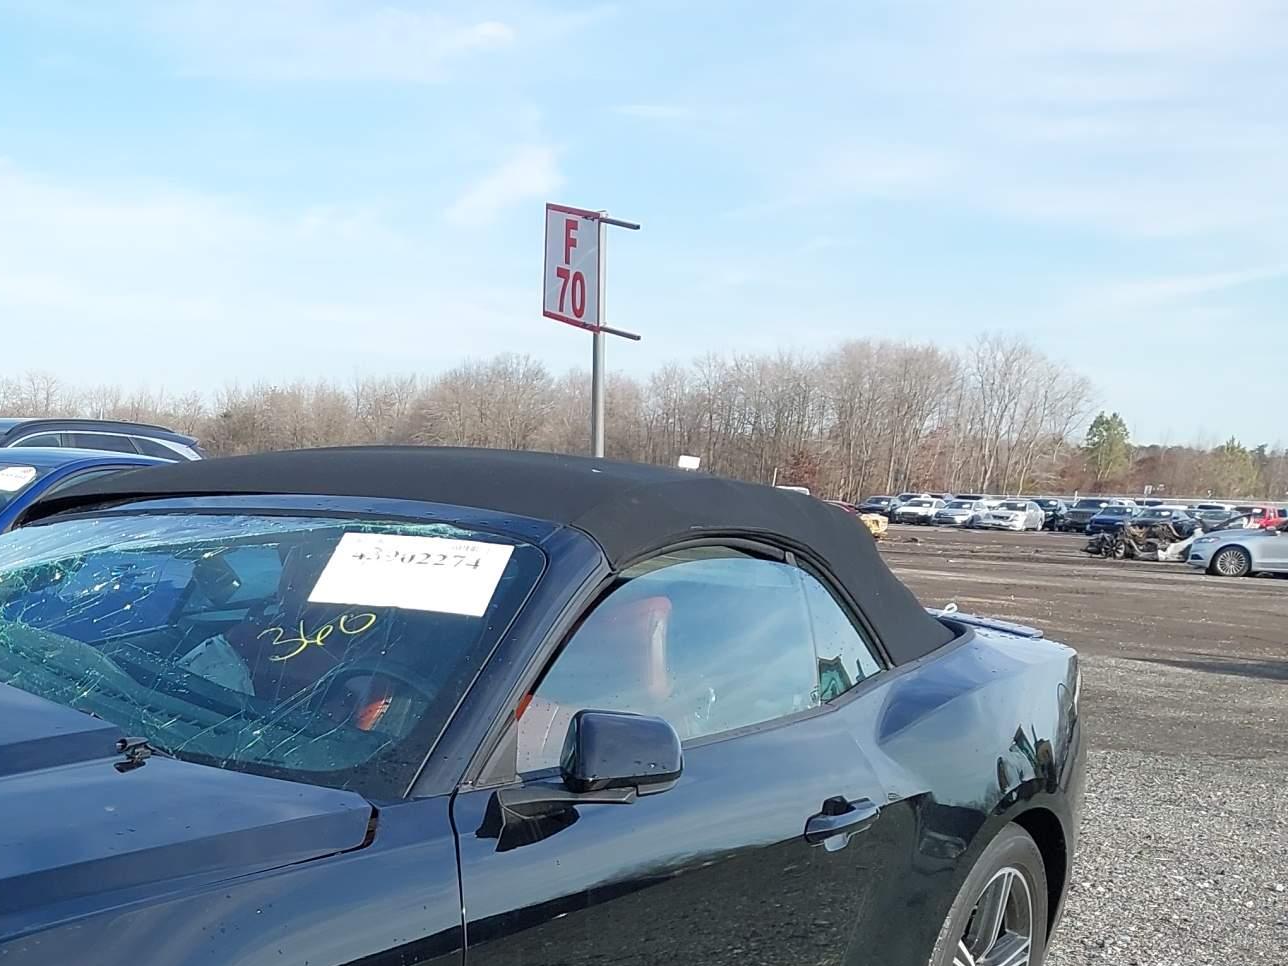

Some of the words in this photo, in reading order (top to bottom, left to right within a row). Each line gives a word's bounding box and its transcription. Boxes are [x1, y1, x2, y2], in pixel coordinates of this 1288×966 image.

[564, 219, 579, 265] F
[556, 266, 586, 319] 70
[257, 612, 377, 661] 360
